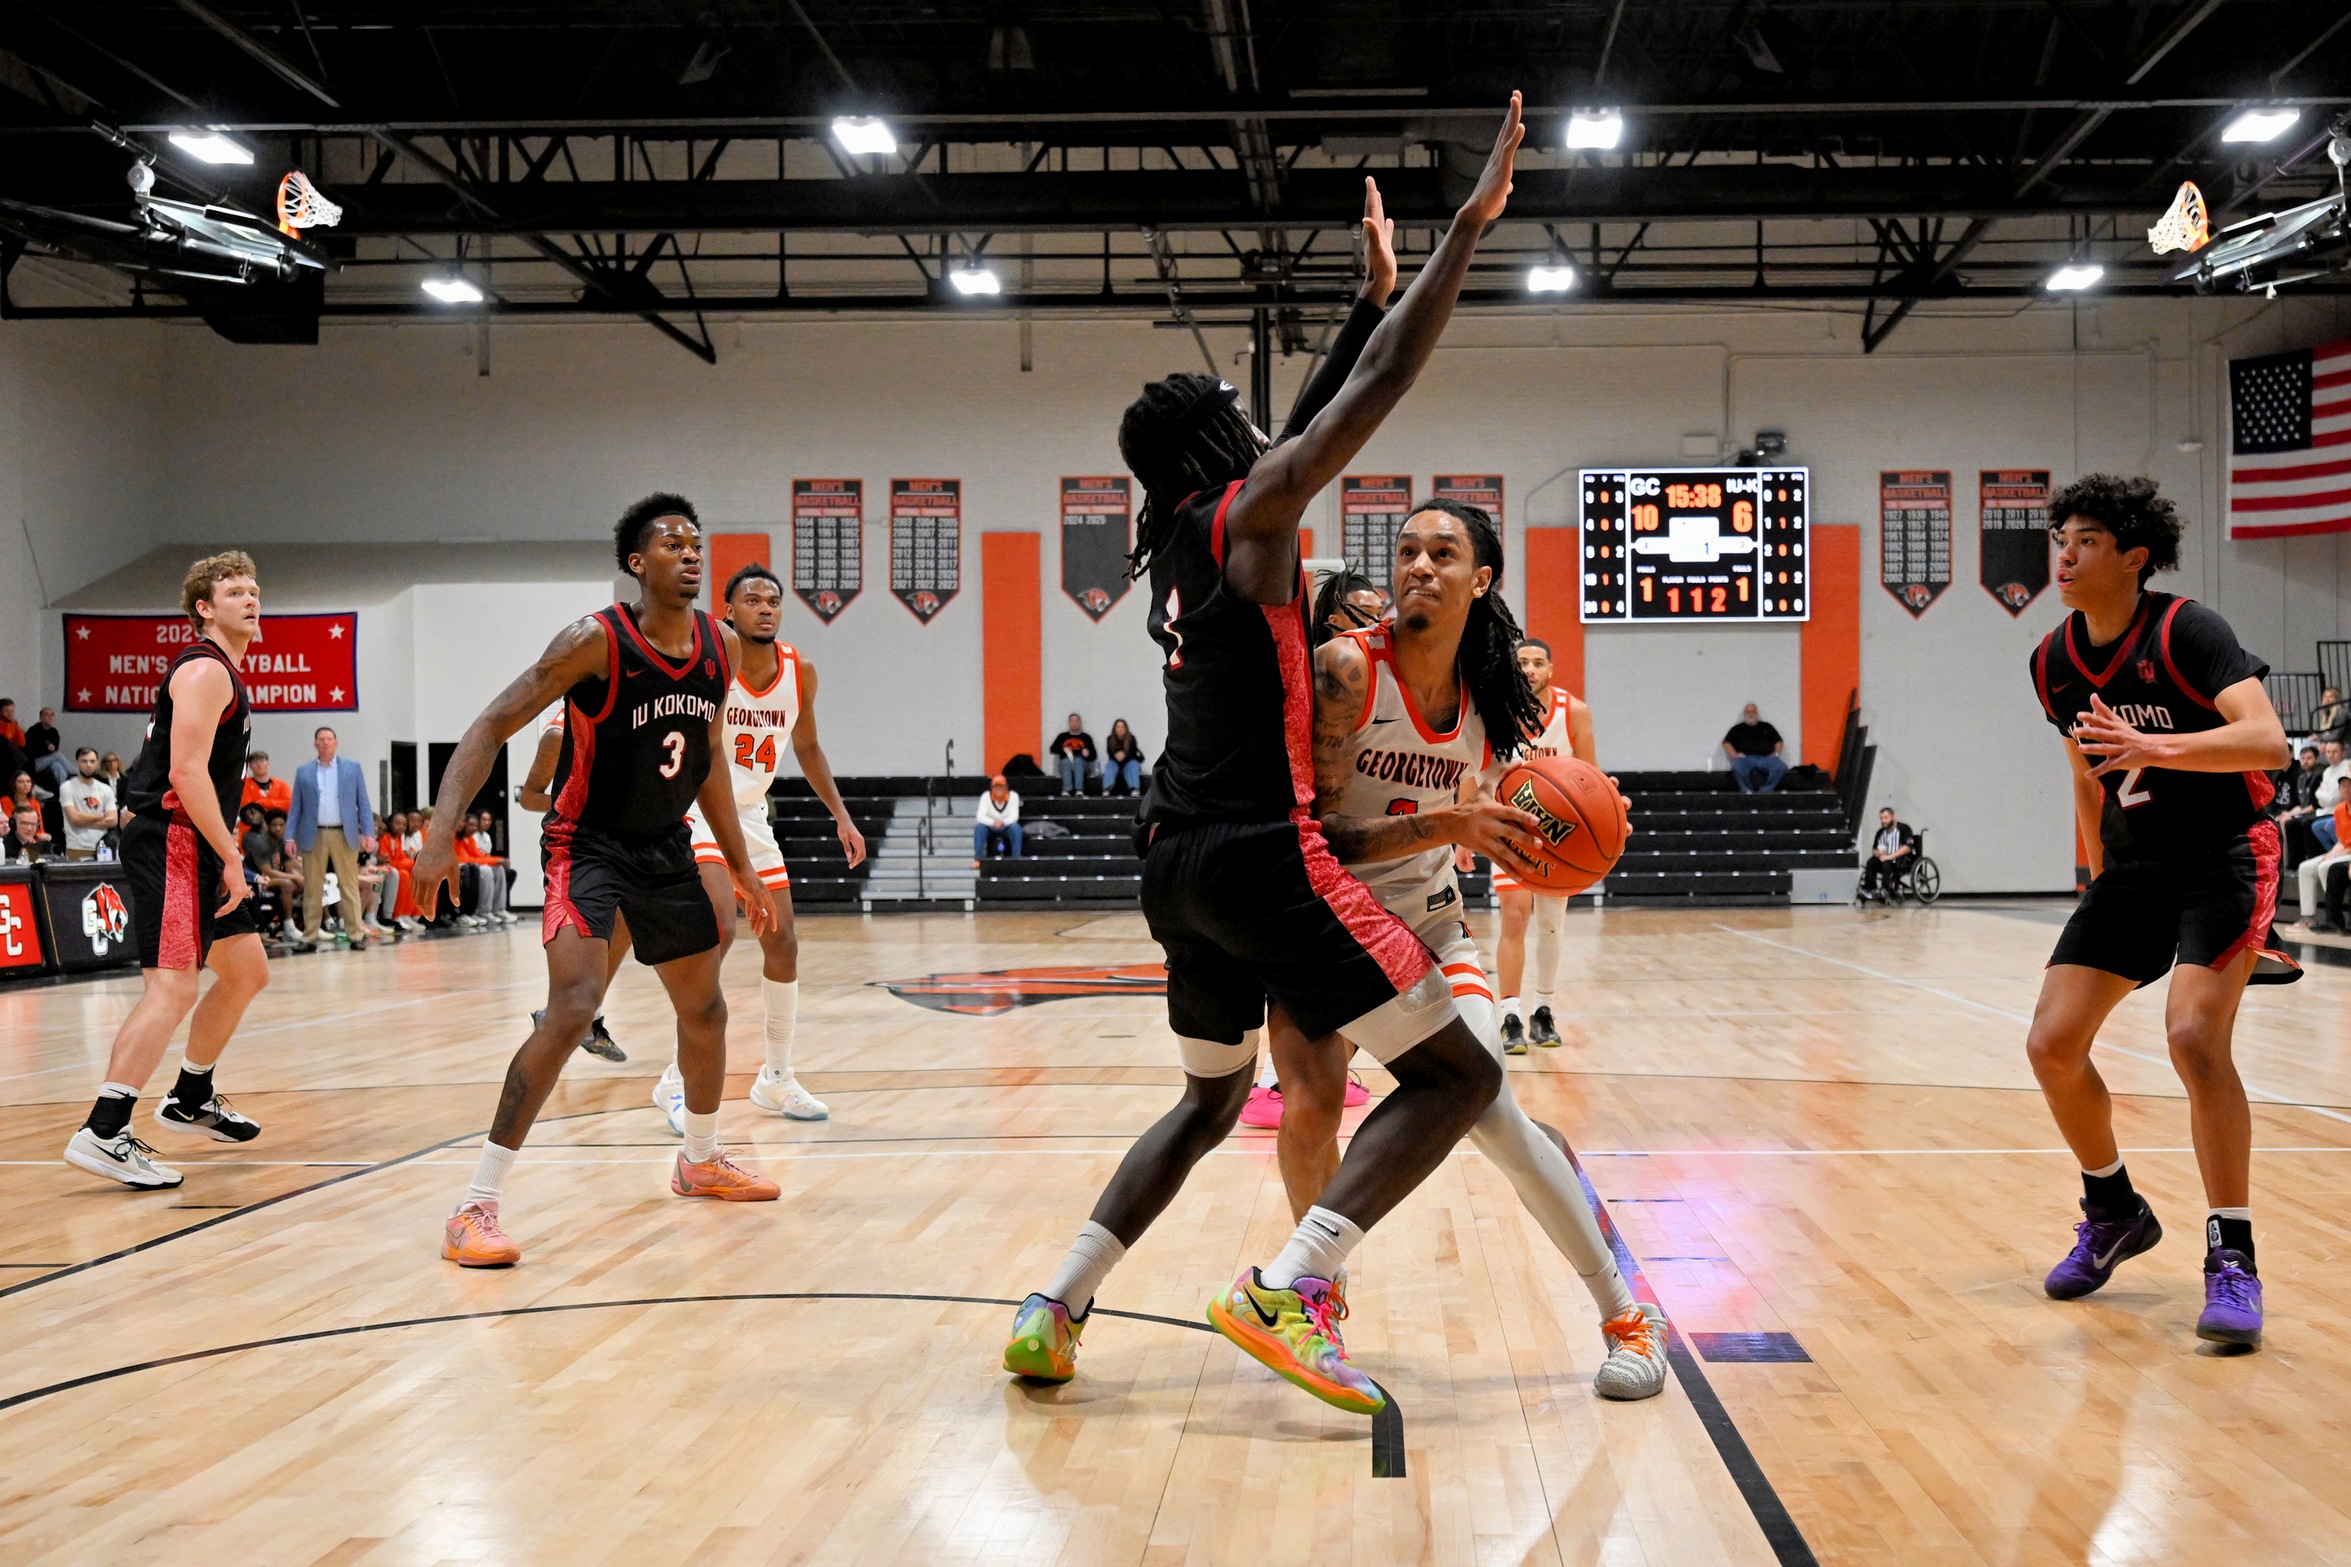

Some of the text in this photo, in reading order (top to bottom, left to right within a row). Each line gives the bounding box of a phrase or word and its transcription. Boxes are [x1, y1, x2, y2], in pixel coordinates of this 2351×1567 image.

[1630, 477, 1757, 508] GC 15:38 IU-K
[1793, 490, 1802, 502] 2
[1631, 501, 1753, 532] 10 6
[1884, 511, 1903, 520] 1927
[1907, 511, 1926, 520] 1930
[2006, 510, 2025, 519] 2011
[1778, 516, 1787, 529] 1
[1793, 516, 1802, 529] 2
[1907, 521, 1926, 530] 1957
[2006, 520, 2025, 529] 2020
[1884, 532, 1903, 541] 1961
[1930, 532, 1949, 541] 1974
[938, 539, 958, 548] 2011
[1705, 542, 1709, 554] 1
[892, 549, 912, 558] 2012
[915, 549, 935, 558] 2013
[938, 559, 958, 568] 2017
[1884, 563, 1903, 572] 1997
[818, 580, 837, 589] 2001
[892, 580, 912, 589] 2021
[915, 580, 935, 589] 2022
[1602, 574, 1610, 586] 1
[1640, 577, 1652, 602] 1
[1736, 577, 1748, 601] 1
[1667, 587, 1726, 612] 1 1 2
[110, 653, 311, 674] MEN'S YBALL
[632, 694, 716, 730] IU KOKOMO
[726, 706, 786, 728] GEORGETOWN
[659, 730, 686, 780] 3
[735, 733, 776, 772] 24
[1523, 747, 1558, 761] GETOWN
[1356, 748, 1469, 790] GEORGETOWN
[1510, 776, 1578, 848] NAIA
